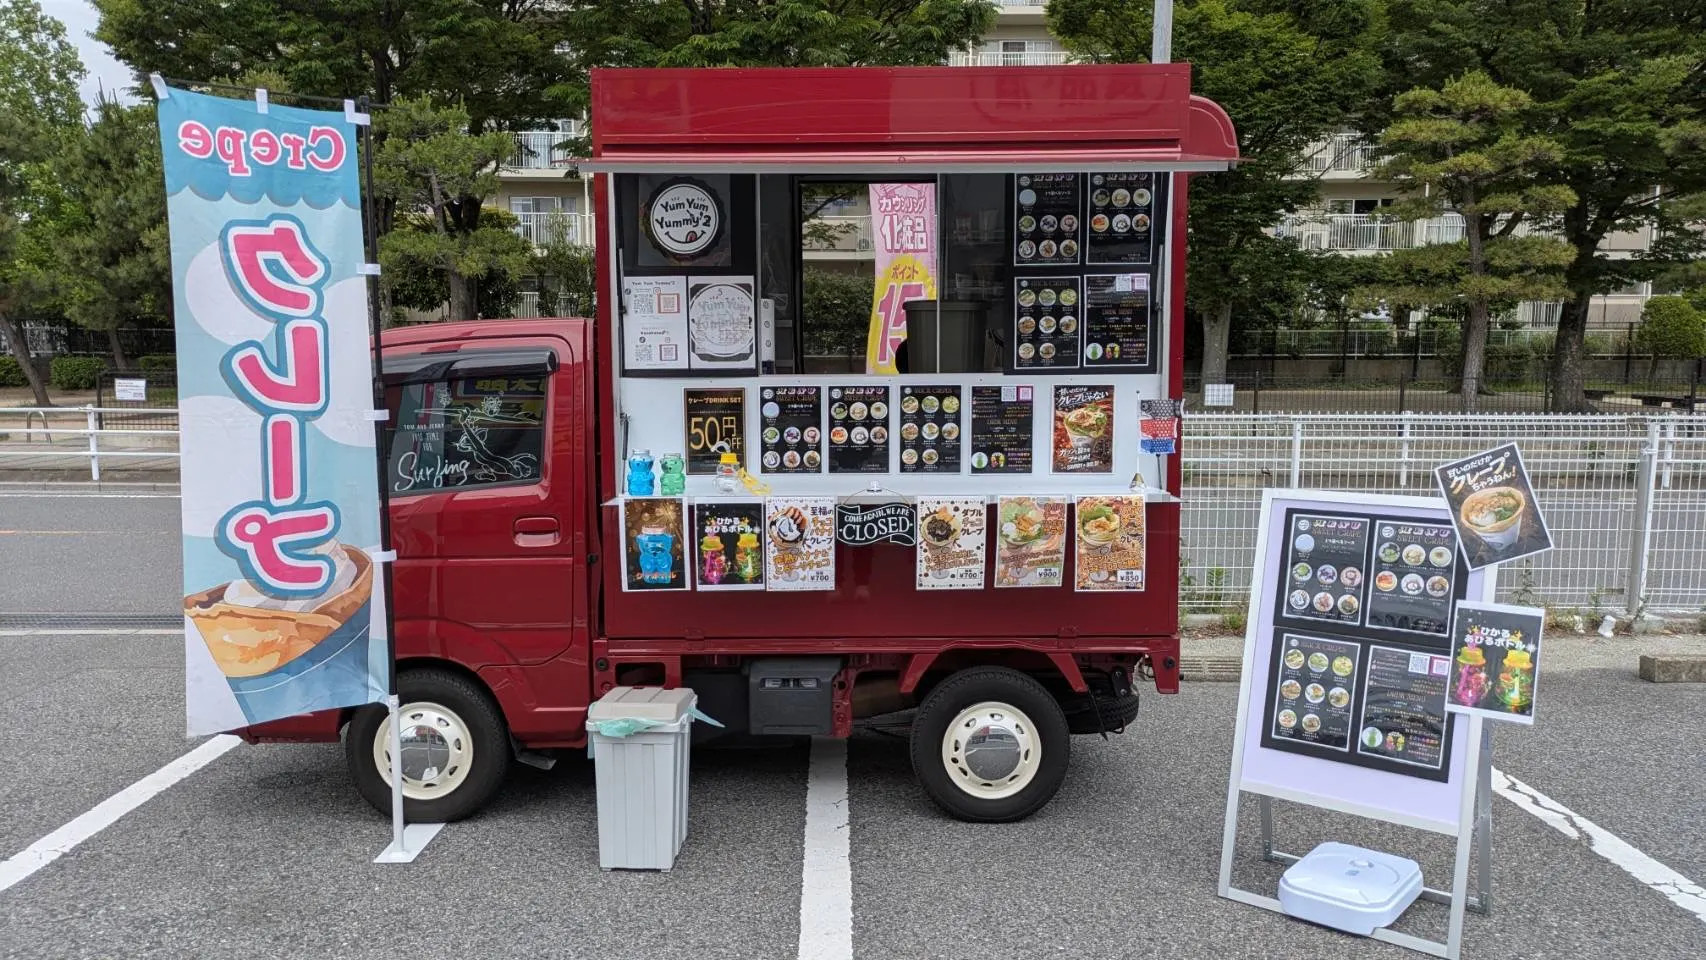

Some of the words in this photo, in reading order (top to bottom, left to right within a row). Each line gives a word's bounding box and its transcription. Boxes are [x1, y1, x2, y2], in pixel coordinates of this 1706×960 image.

[660, 201, 685, 213] Yum
[686, 198, 709, 213] Yum
[880, 213, 927, 252] 化粧品
[891, 264, 918, 280] ポイント
[395, 452, 470, 491] Surfing
[1447, 455, 1492, 478] 甘いのだけが
[1450, 452, 1510, 494] クレープ
[810, 506, 833, 516] 至福の
[896, 508, 910, 516] ARE
[962, 508, 984, 516] ダブル
[716, 517, 740, 525] ひかる
[842, 516, 910, 540] CLOSED
[960, 527, 984, 536] クレープ
[1480, 626, 1510, 638] ひかる
[1464, 634, 1526, 651] あひるボトル
